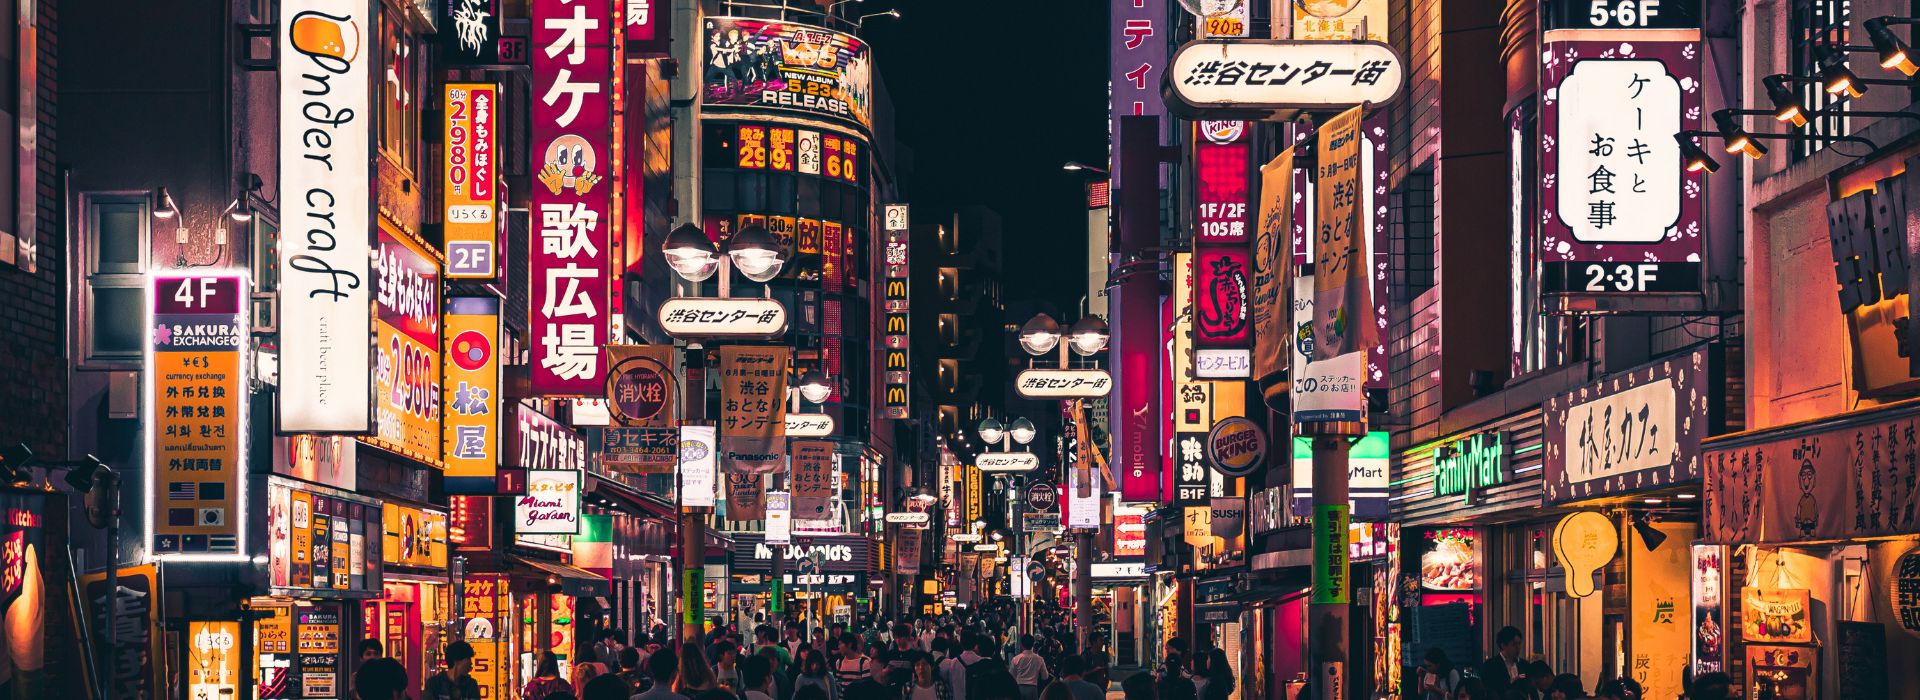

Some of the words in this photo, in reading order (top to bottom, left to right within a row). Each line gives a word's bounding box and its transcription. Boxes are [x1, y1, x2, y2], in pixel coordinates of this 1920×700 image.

[502, 41, 523, 59] 3F
[542, 0, 600, 128] オケ
[785, 72, 806, 80] NEW
[806, 75, 833, 84] ALBUM
[1183, 60, 1391, 86] 渋谷センター街
[450, 90, 467, 98] 60分
[788, 80, 831, 97] 5.23
[763, 91, 848, 115] RELEASE
[1209, 120, 1237, 133] KING
[1626, 72, 1652, 194] ケーキと
[450, 101, 467, 195] 2,980円
[474, 95, 489, 196] 全身もみほぐし
[1587, 132, 1617, 231] お食事
[452, 209, 488, 219] りらくる
[1200, 203, 1246, 219] 1F/2F
[770, 218, 794, 232] 30分
[1201, 222, 1245, 236] 105席
[289, 188, 361, 302] craft
[454, 248, 486, 269] 2F
[174, 277, 217, 308] 4F
[378, 243, 437, 334] 全身もみほぐし
[541, 202, 598, 380] 歌広場
[665, 309, 779, 324] 渋谷センター街
[173, 324, 240, 336] SAKURA
[173, 336, 230, 346] EXCHANGE
[376, 347, 390, 386] 0分
[1197, 356, 1249, 371] センタービル
[195, 373, 226, 381] exchange
[1022, 378, 1108, 389] 渋谷センター街
[1320, 375, 1356, 383] ステッカー
[620, 383, 662, 403] 消火栓
[740, 380, 769, 395] 渋谷
[1295, 378, 1317, 393] この
[1181, 384, 1206, 404] 鍋
[726, 399, 781, 412] おとなり
[451, 381, 489, 459] 松屋
[726, 417, 781, 430] サンデー
[166, 424, 192, 437] 외화
[200, 424, 225, 437] 환전
[623, 429, 675, 446] セキネ
[1215, 429, 1256, 450] BURGER
[729, 452, 779, 462] Panasonic
[1217, 440, 1258, 462] KING
[169, 459, 222, 471] 外貨両替
[1433, 430, 1503, 505] FamilyMart
[1031, 492, 1052, 502] 消火栓
[1180, 489, 1205, 499] B1F
[1186, 509, 1211, 525] すし
[1212, 510, 1244, 519] SUSHI
[755, 543, 853, 561] MDold's
